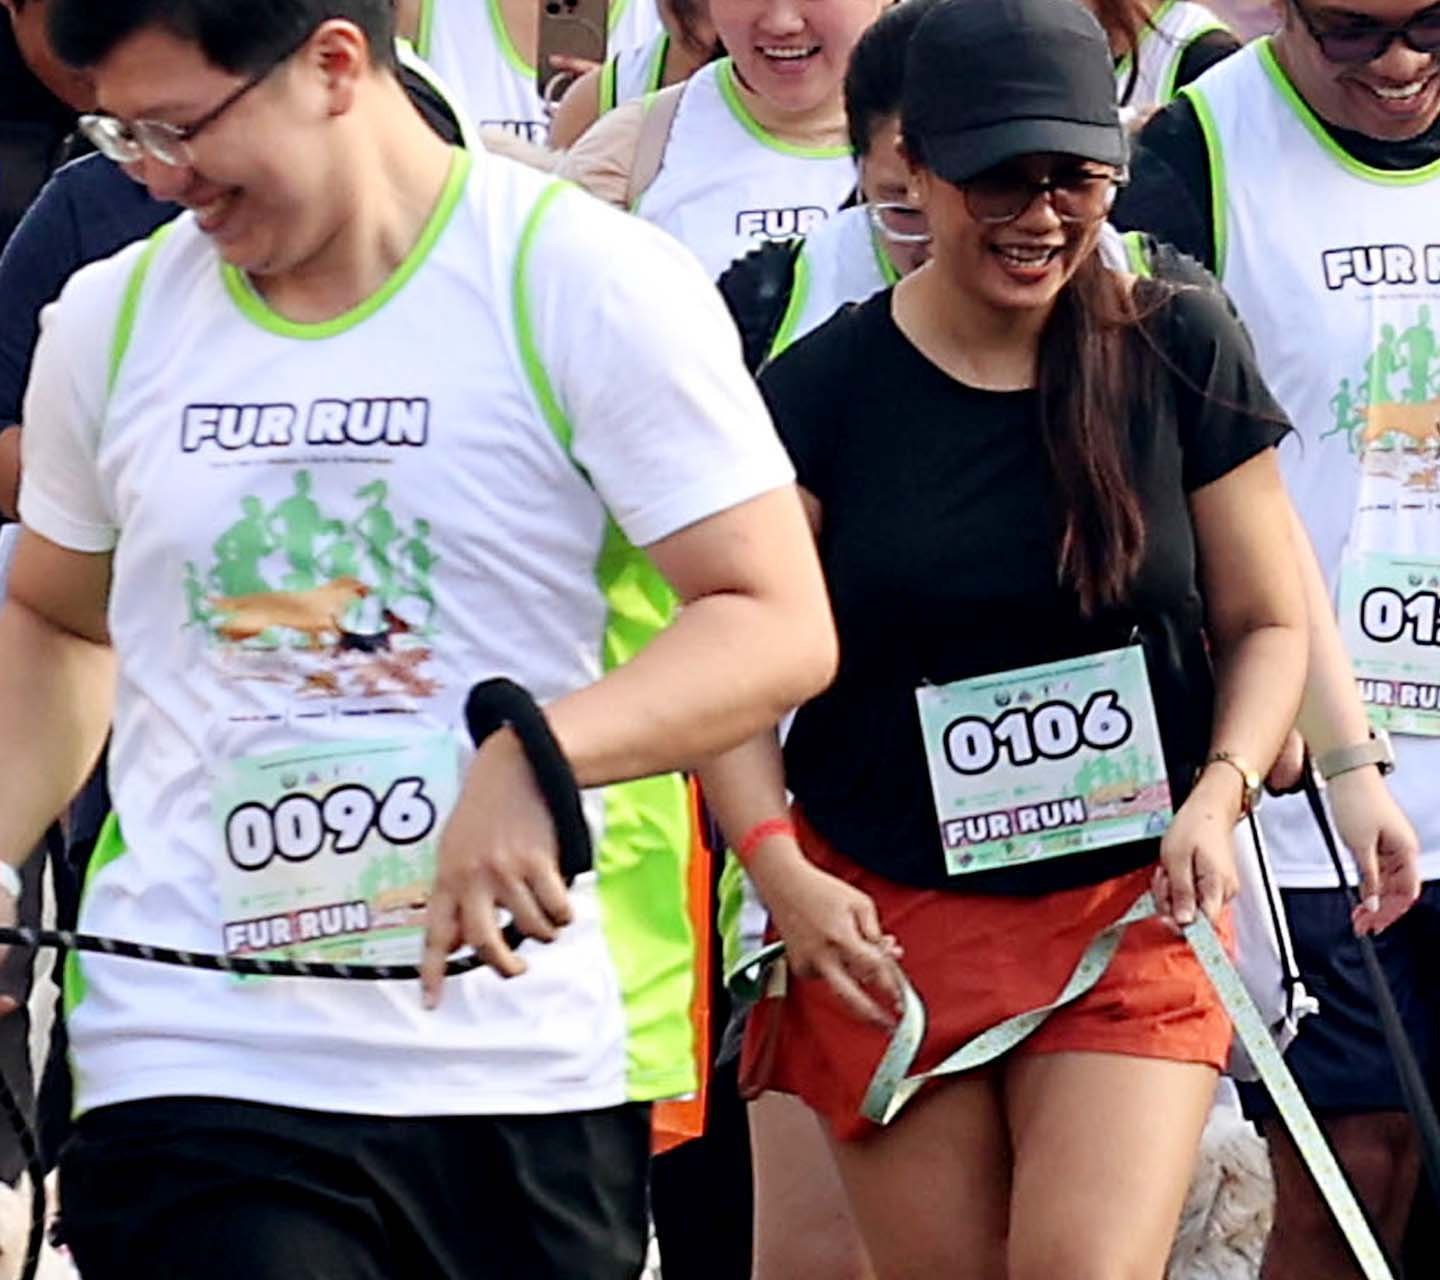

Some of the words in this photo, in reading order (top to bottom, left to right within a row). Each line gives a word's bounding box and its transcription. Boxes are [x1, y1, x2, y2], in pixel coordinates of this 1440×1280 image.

[1322, 244, 1415, 290] FUR
[181, 403, 297, 453] FUR
[305, 397, 429, 448] RUN
[1355, 677, 1396, 707] UR
[943, 689, 1133, 775] 0106
[225, 776, 437, 872] 0096
[941, 811, 1011, 849] FUR
[1015, 795, 1088, 833] RUN
[224, 913, 292, 956] FUR
[294, 900, 371, 941] RUN
